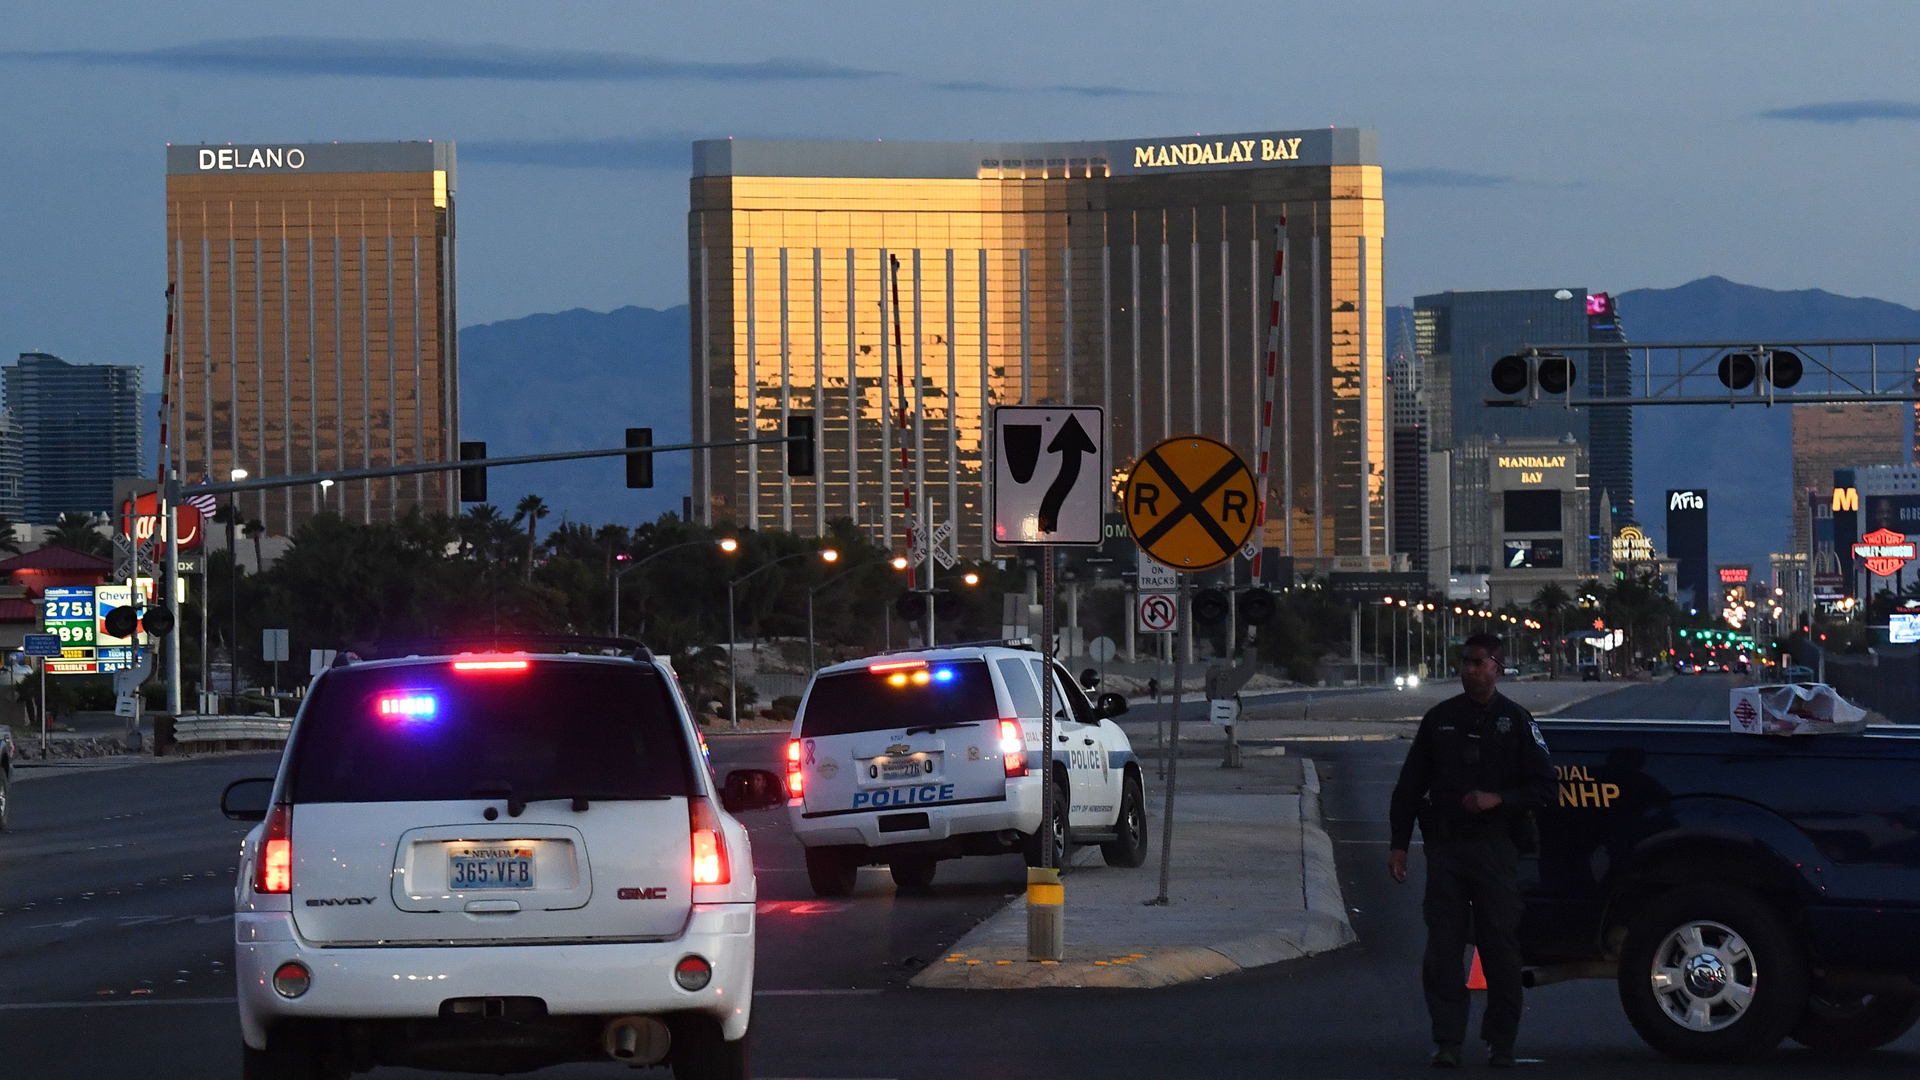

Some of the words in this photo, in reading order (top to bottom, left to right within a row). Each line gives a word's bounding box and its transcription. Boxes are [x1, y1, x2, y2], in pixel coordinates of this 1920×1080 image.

[199, 148, 305, 170] DELANO
[1134, 140, 1255, 168] MANDALAY
[1261, 138, 1302, 161] BAY
[1498, 456, 1566, 468] MANDALAY
[1521, 471, 1543, 484] BAY
[1133, 482, 1160, 516] R
[1222, 489, 1248, 524] R
[1670, 491, 1704, 511] Aria
[1612, 537, 1630, 549] NEW
[1612, 549, 1630, 560] NEW
[1141, 576, 1175, 587] TRACKS
[99, 591, 143, 601] Chevrn
[46, 602, 83, 617] 275
[1070, 750, 1101, 769] POLICE
[852, 783, 955, 809] POLICE
[1559, 783, 1620, 807] NHP
[472, 849, 512, 858] NEVADA
[617, 886, 668, 900] GMC
[305, 896, 378, 907] ENVOY
